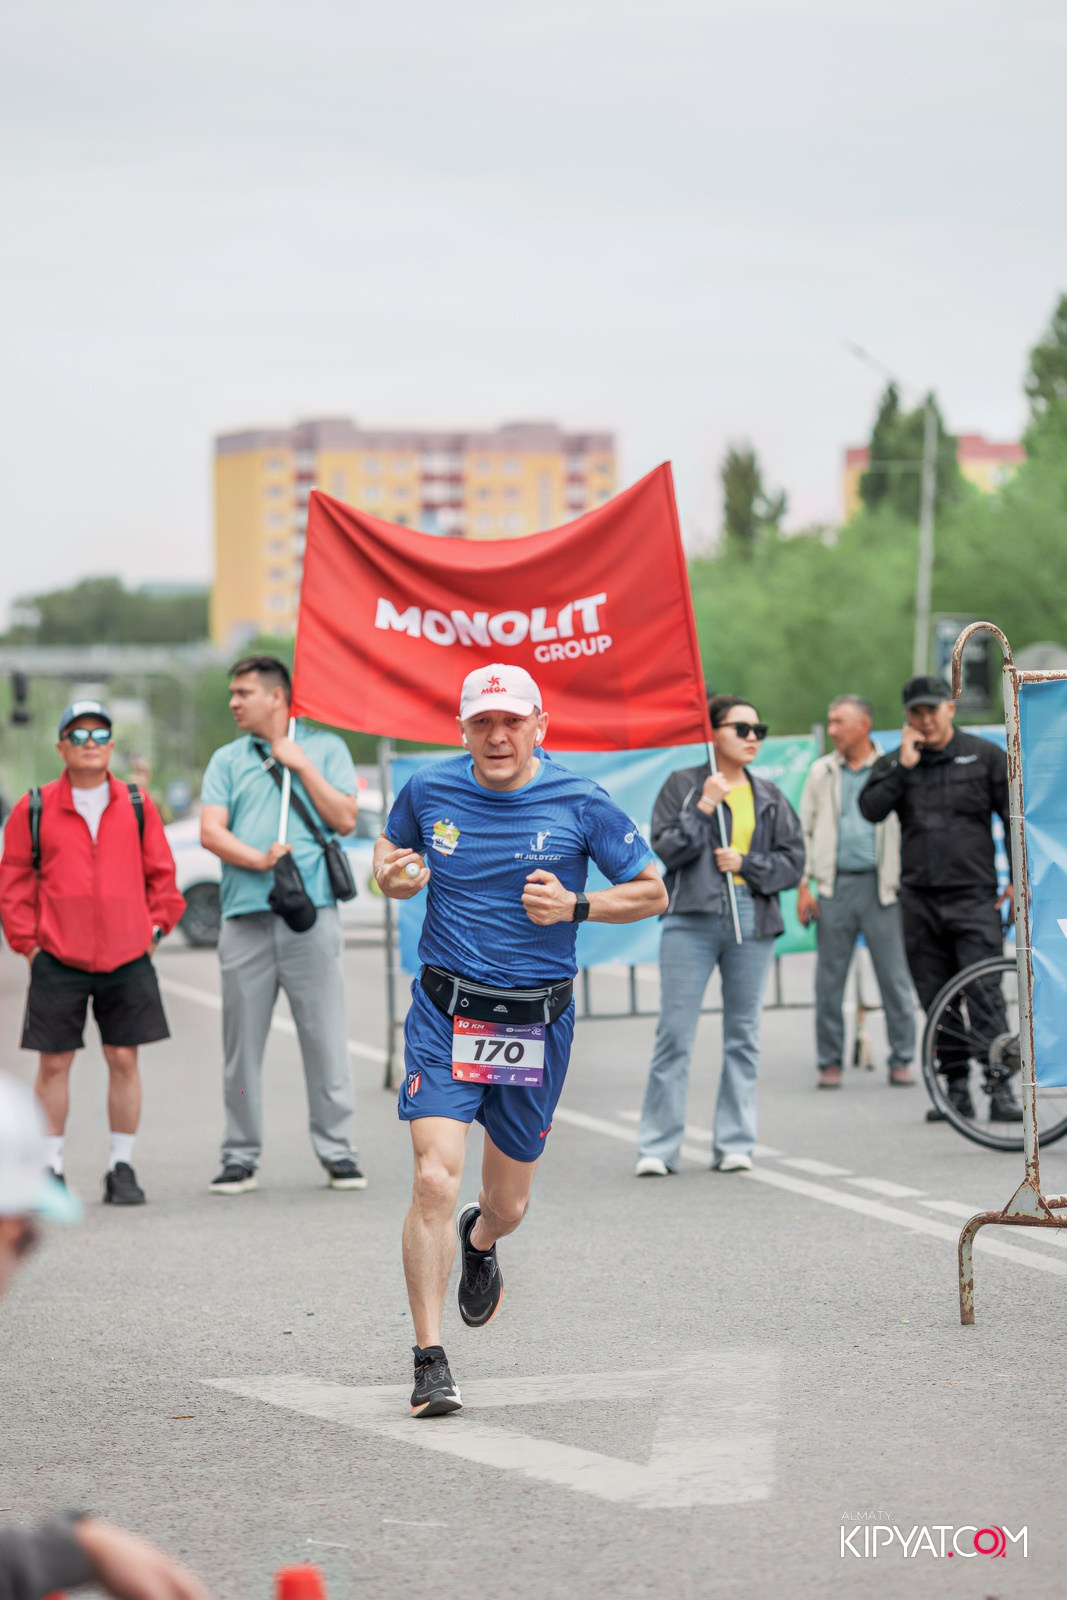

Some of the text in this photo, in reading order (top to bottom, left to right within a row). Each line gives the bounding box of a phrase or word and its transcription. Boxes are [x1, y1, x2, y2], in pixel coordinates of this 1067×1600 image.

[375, 592, 607, 647] MONOLIT
[534, 634, 613, 663] GROUP
[458, 1020, 470, 1029] 10
[473, 1039, 525, 1064] 170
